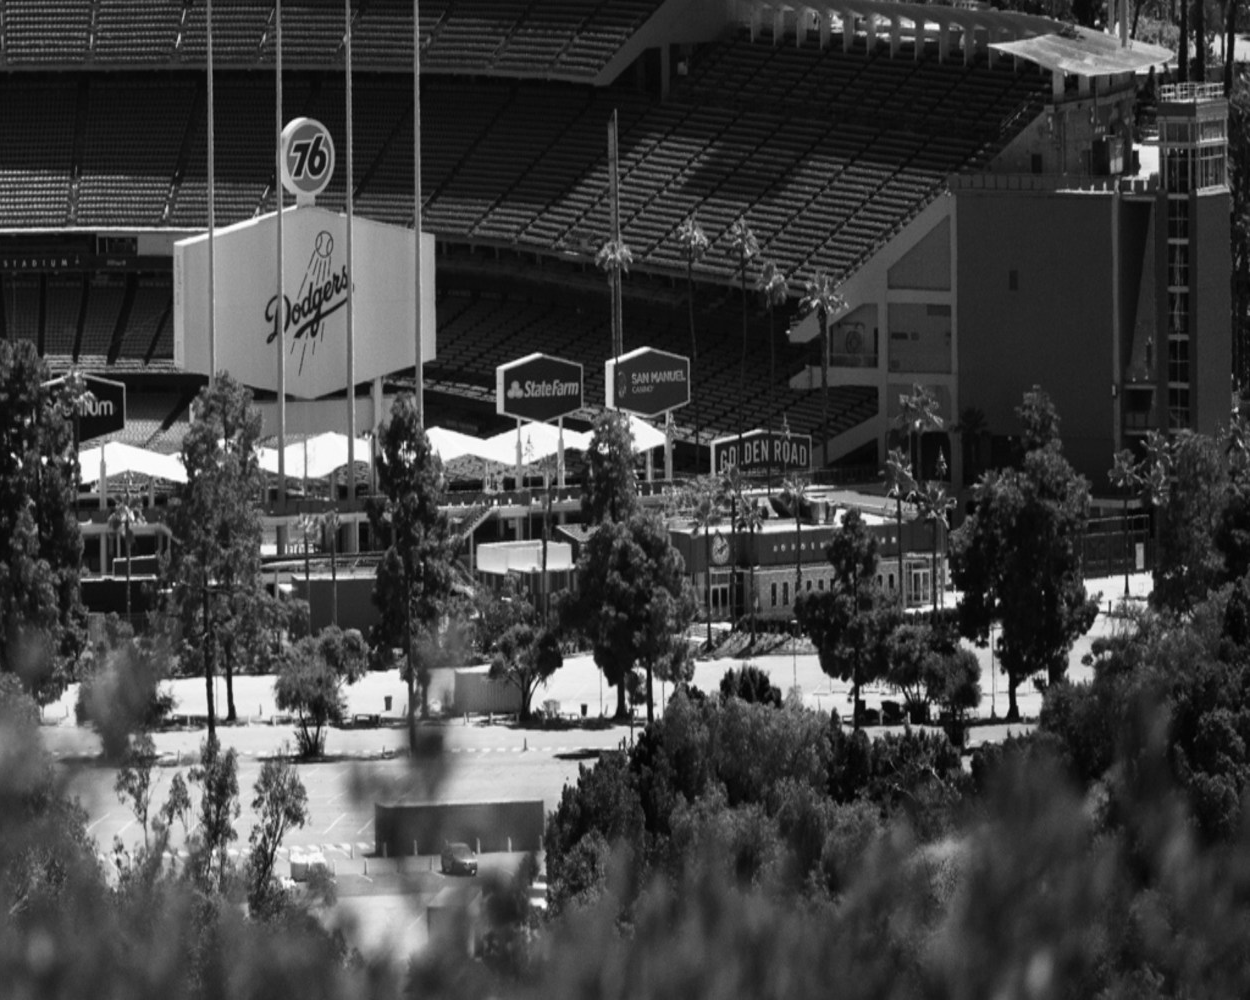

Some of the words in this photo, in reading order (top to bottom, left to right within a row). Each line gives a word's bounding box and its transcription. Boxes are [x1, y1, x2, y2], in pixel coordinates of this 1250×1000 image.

[290, 133, 329, 180] 76
[3, 259, 68, 269] STADIUM
[265, 265, 352, 344] Dodgers
[632, 372, 649, 385] SAN
[651, 370, 686, 383] MANUEL
[720, 440, 769, 471] GOLDEN
[774, 440, 807, 466] ROAD
